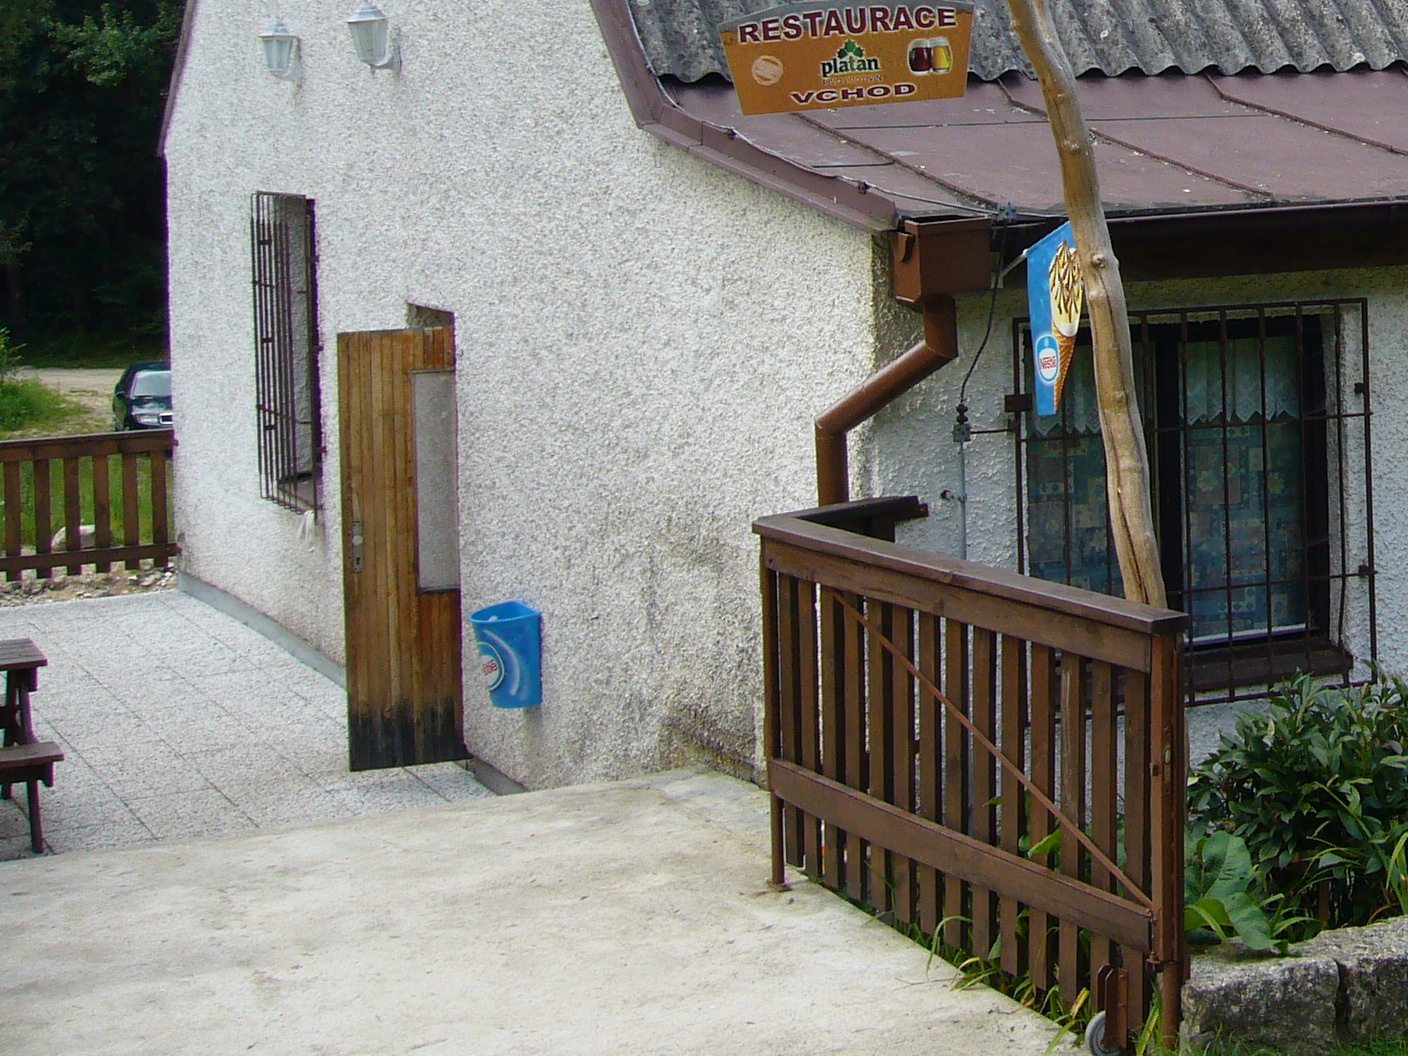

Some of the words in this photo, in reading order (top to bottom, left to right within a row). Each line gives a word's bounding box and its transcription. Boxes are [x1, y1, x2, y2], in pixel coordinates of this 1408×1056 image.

[738, 6, 957, 44] RESTAURACE
[821, 55, 880, 78] platan
[790, 84, 916, 104] VCHOD
